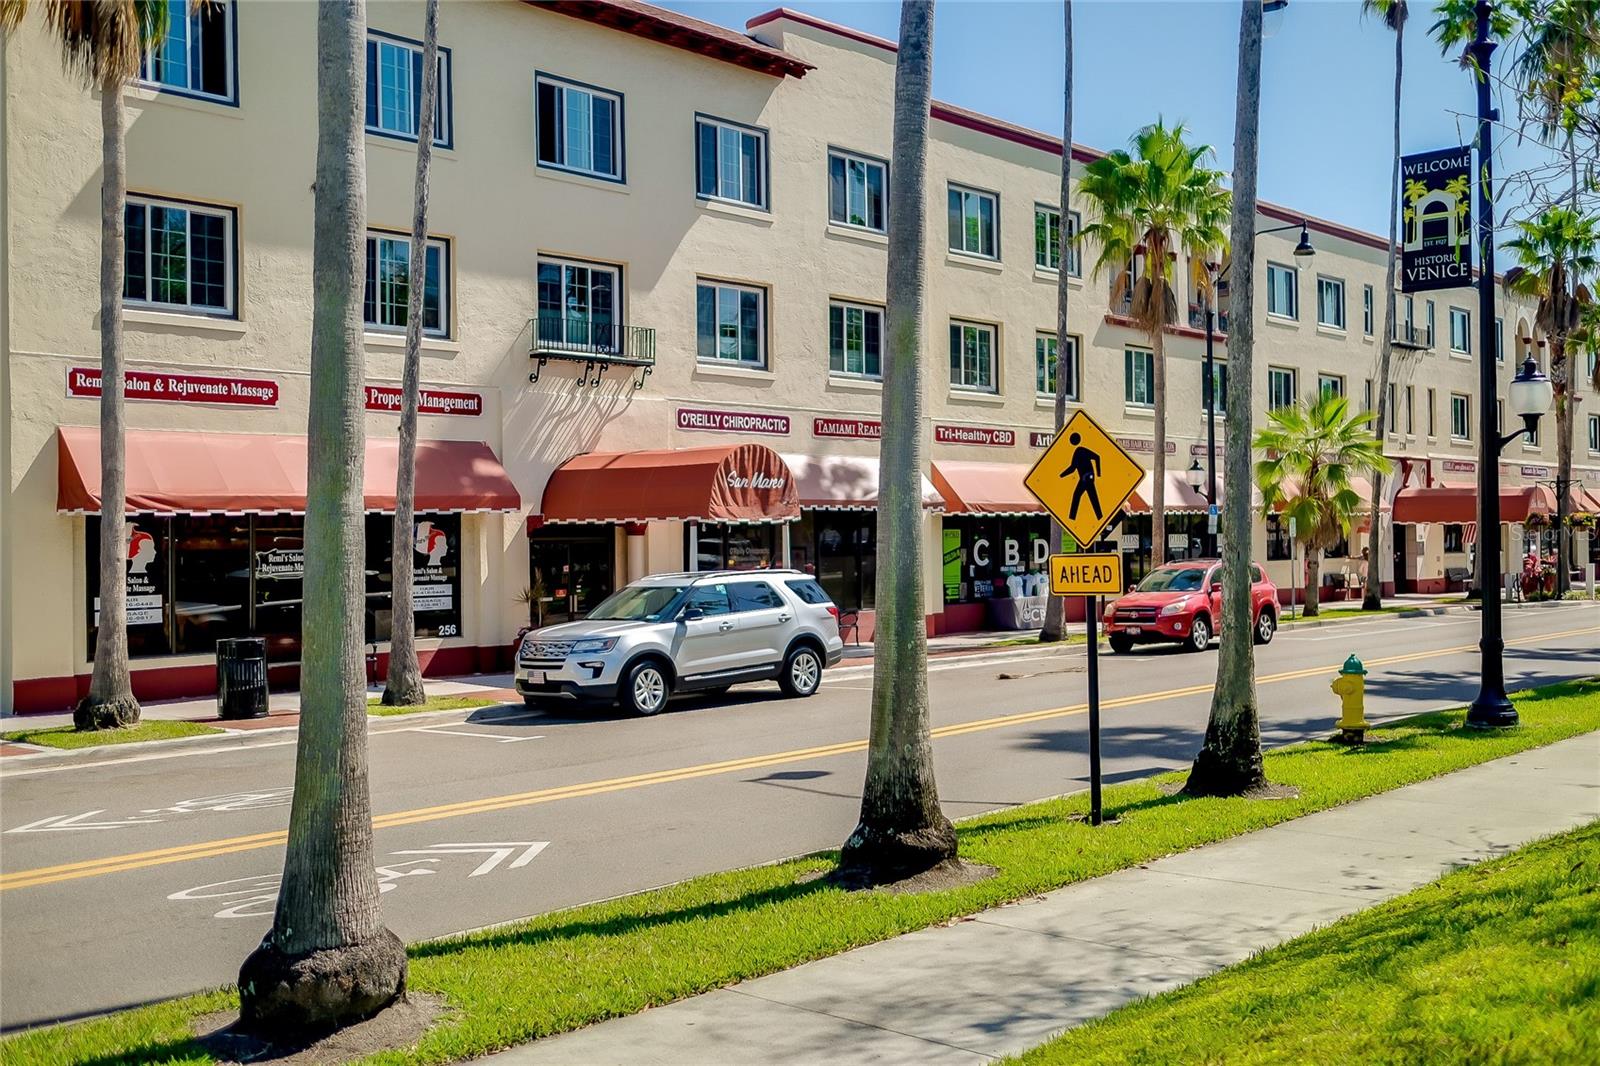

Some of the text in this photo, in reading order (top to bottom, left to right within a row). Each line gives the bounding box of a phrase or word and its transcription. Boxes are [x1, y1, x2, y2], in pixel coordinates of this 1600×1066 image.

[1404, 155, 1470, 176] WELCOME
[1406, 262, 1468, 281] VENICE
[76, 372, 102, 388] Rem
[153, 378, 165, 392] &
[168, 378, 228, 395] Rejuvenate
[230, 382, 274, 400] Massage
[370, 388, 403, 409] Prope
[418, 391, 479, 413] Management
[680, 412, 788, 432] O'REILLY CHIROPRACTIC
[816, 419, 882, 436] TAMIAMI REALT
[937, 427, 1013, 444] Tri-Healthy CBD
[1035, 434, 1055, 446] Arti
[726, 470, 785, 490] San Marco
[1059, 565, 1112, 584] AHEAD
[438, 624, 457, 637] 256
